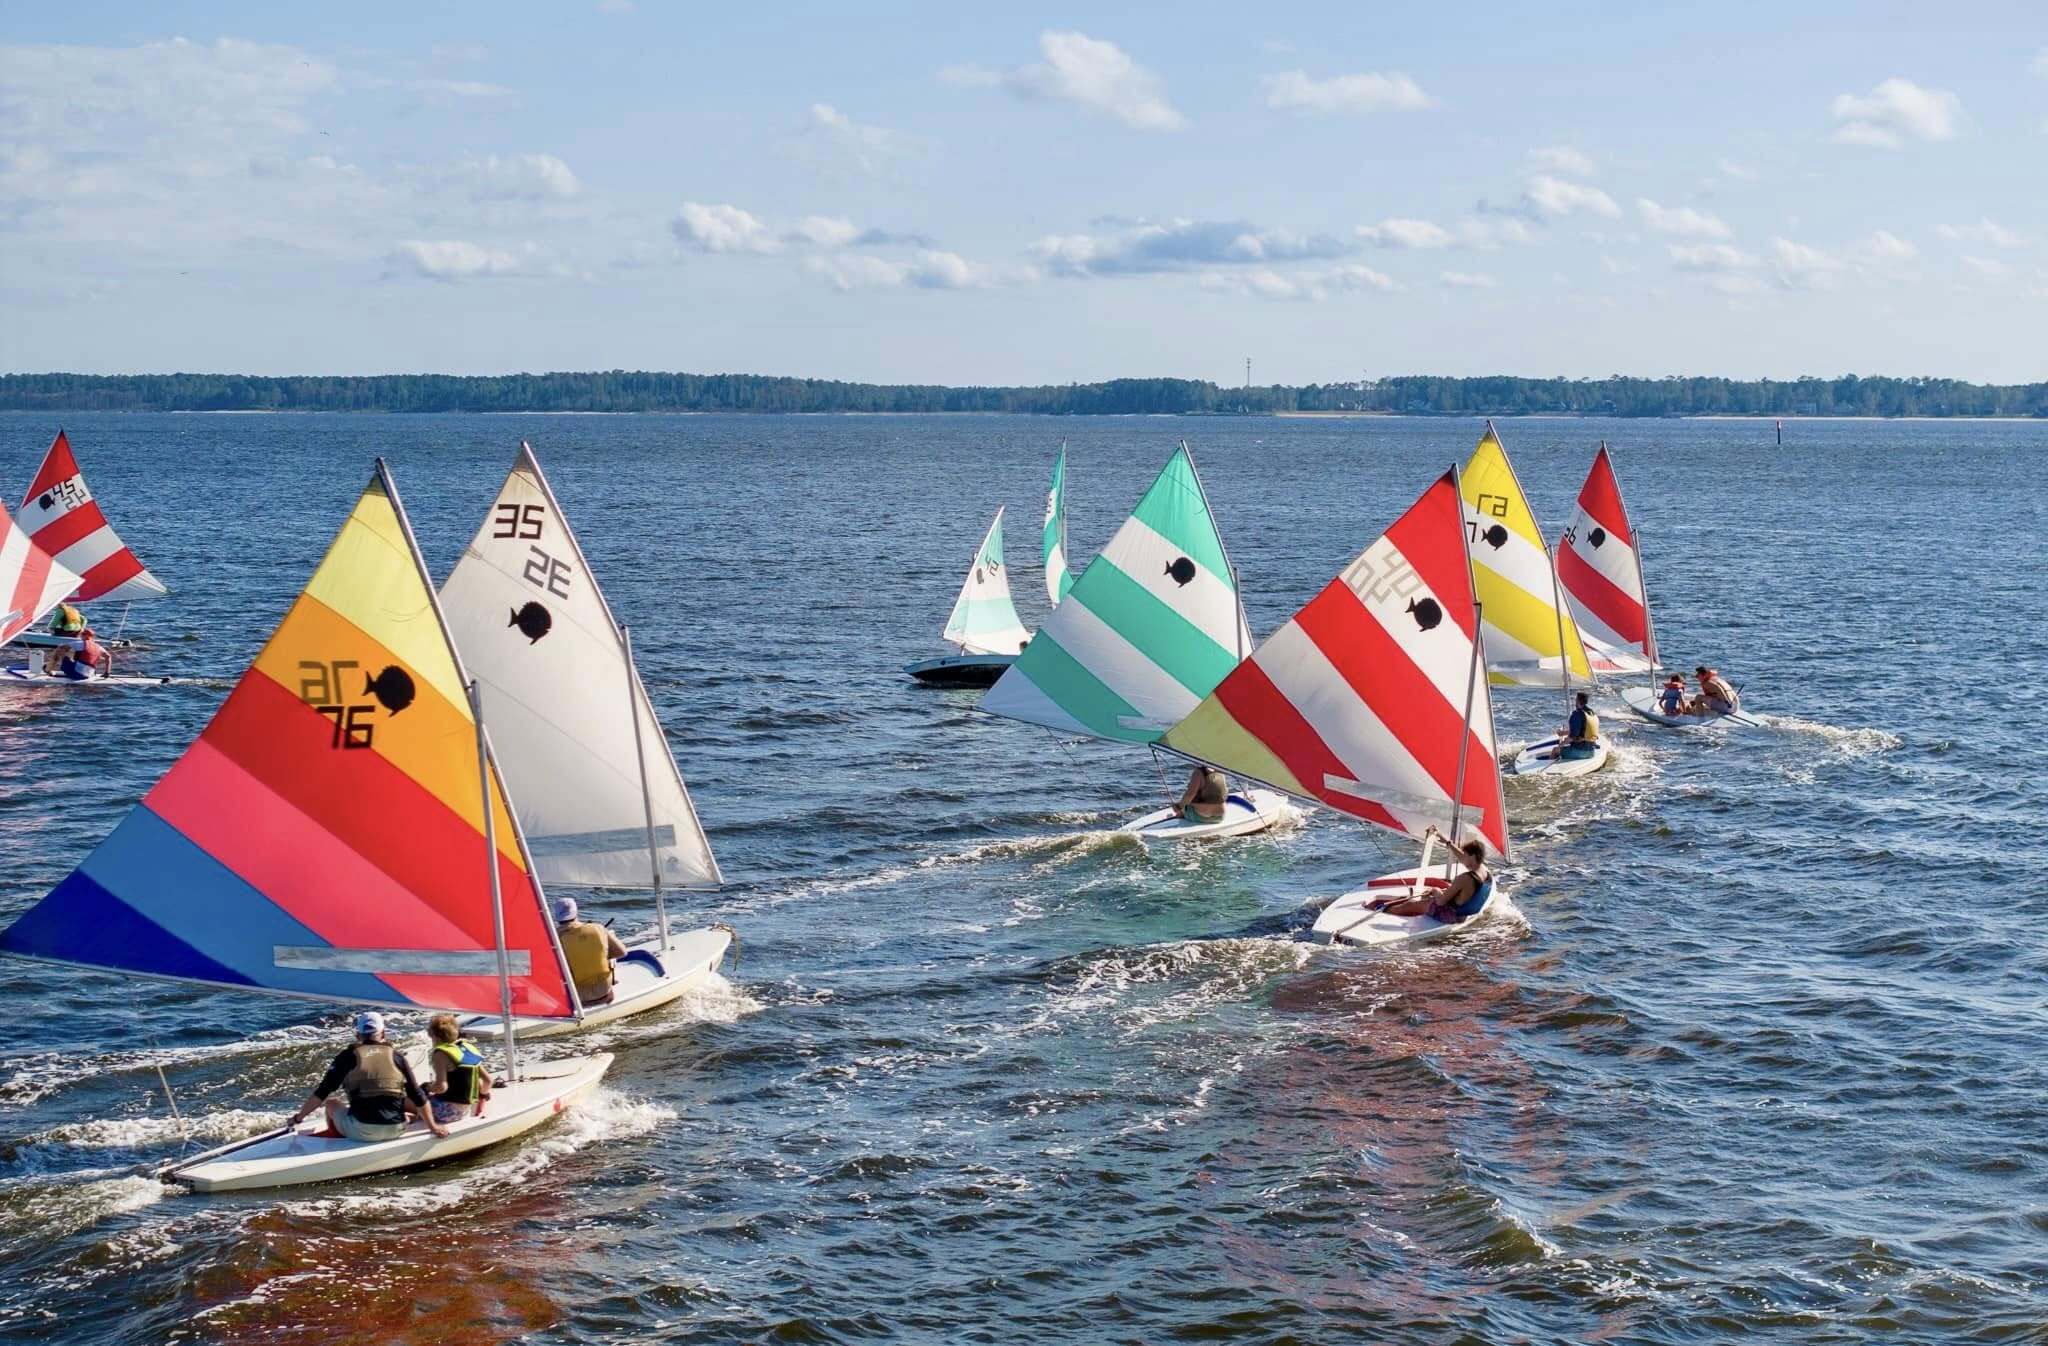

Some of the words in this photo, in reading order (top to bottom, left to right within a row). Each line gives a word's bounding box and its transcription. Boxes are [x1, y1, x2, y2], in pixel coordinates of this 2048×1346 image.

[53, 479, 75, 498] 45
[493, 504, 544, 540] 35
[315, 705, 376, 750] 76
